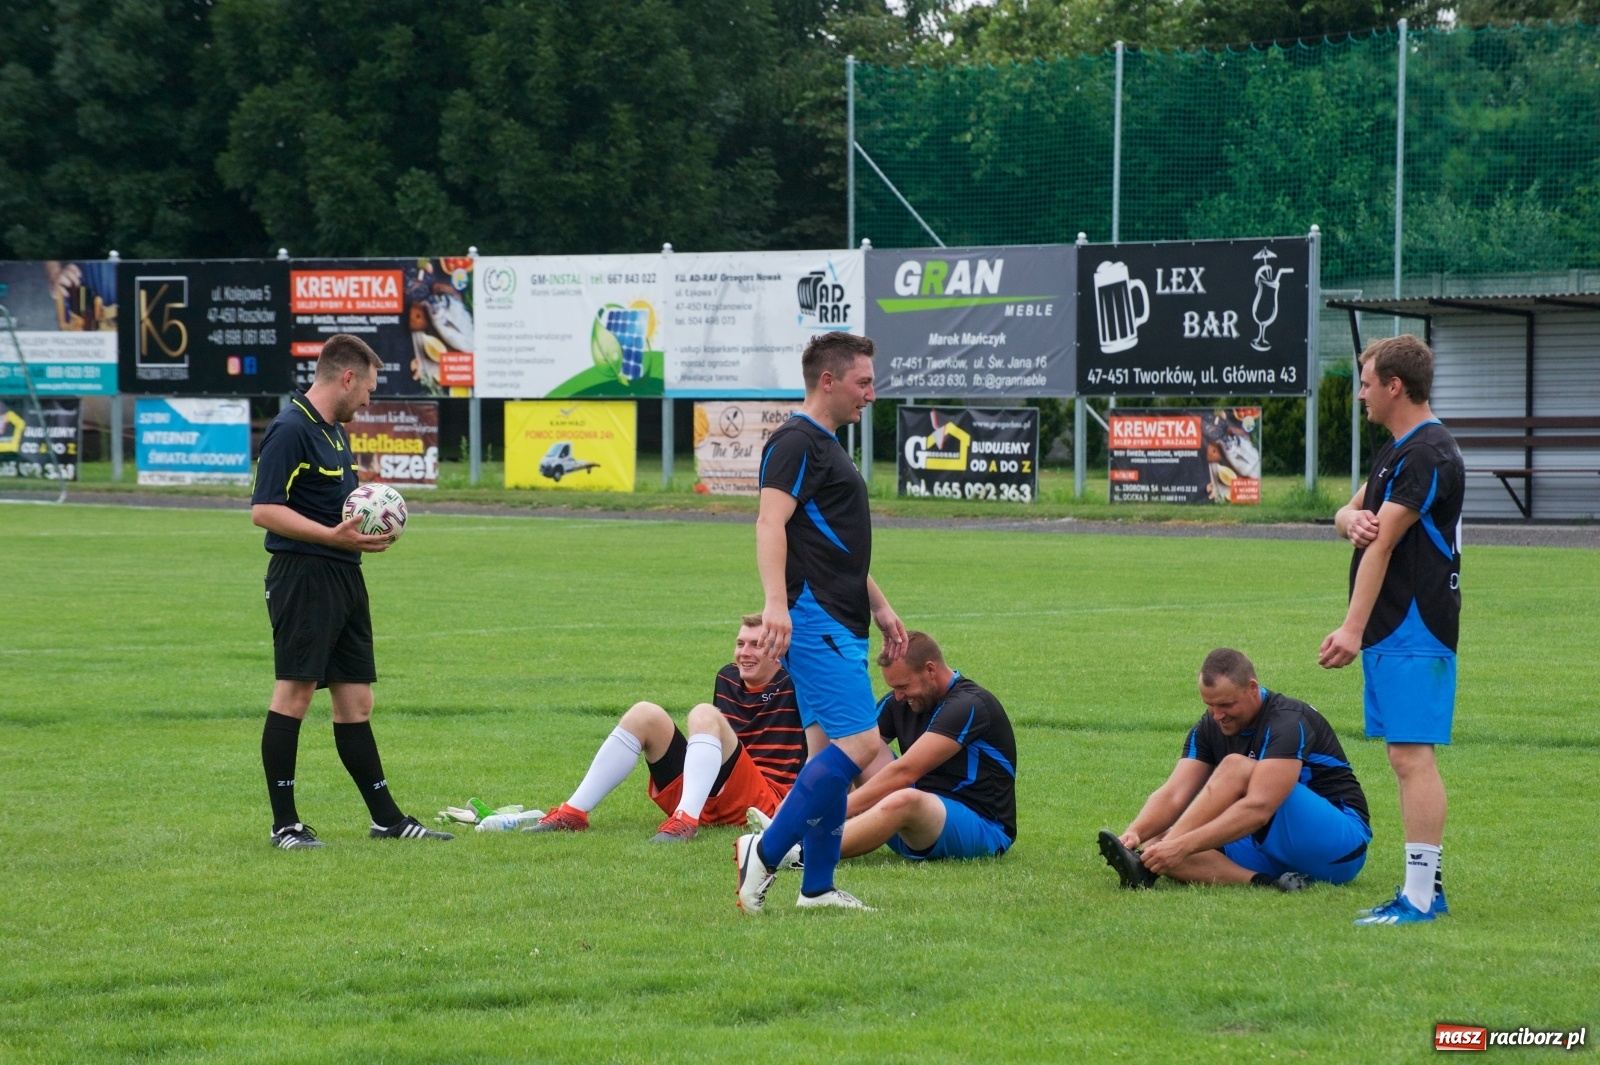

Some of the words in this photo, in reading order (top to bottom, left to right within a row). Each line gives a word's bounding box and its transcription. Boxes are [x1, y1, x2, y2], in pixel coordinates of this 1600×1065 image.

[530, 274, 582, 286] GM-INSTAL
[607, 274, 622, 284] 667
[624, 274, 640, 284] 843
[642, 273, 656, 284] 022
[690, 274, 718, 282] AD-RAF
[720, 273, 754, 284] Grzegorz
[756, 273, 782, 281] Nowak
[894, 259, 1004, 296] GRAN
[1156, 267, 1206, 294] LEX
[264, 284, 272, 301] 5
[296, 276, 398, 298] KREWETKA
[819, 284, 844, 303] AD
[819, 304, 852, 323] RAF
[1005, 304, 1054, 316] MEBLE
[1184, 310, 1240, 338] BAR
[929, 333, 959, 346] Marek
[962, 332, 1006, 347] Mańczyk
[890, 357, 922, 369] 47-451
[926, 357, 968, 370] Tworków,
[973, 356, 984, 368] ul.
[988, 354, 1004, 369] Św.
[1008, 356, 1032, 369] Jana
[1035, 356, 1047, 368] 16
[927, 374, 945, 386] 323
[1088, 368, 1129, 384] 47-451
[1133, 366, 1196, 386] Tworków,
[1201, 366, 1218, 383] ul.
[1222, 366, 1275, 383] Główna
[1280, 366, 1296, 383] 43
[1114, 420, 1197, 438] KREWETKA
[142, 431, 200, 445] INTERNET
[711, 442, 727, 458] The
[971, 441, 1030, 455] BUDUJEMY
[380, 446, 438, 479] szef
[970, 460, 988, 472] OD
[988, 460, 998, 472] A
[1000, 460, 1018, 473] DO
[1022, 461, 1031, 473] Z
[906, 479, 931, 497] tel.
[933, 481, 962, 499] 665
[964, 482, 997, 500] 092
[1000, 483, 1032, 503] 363
